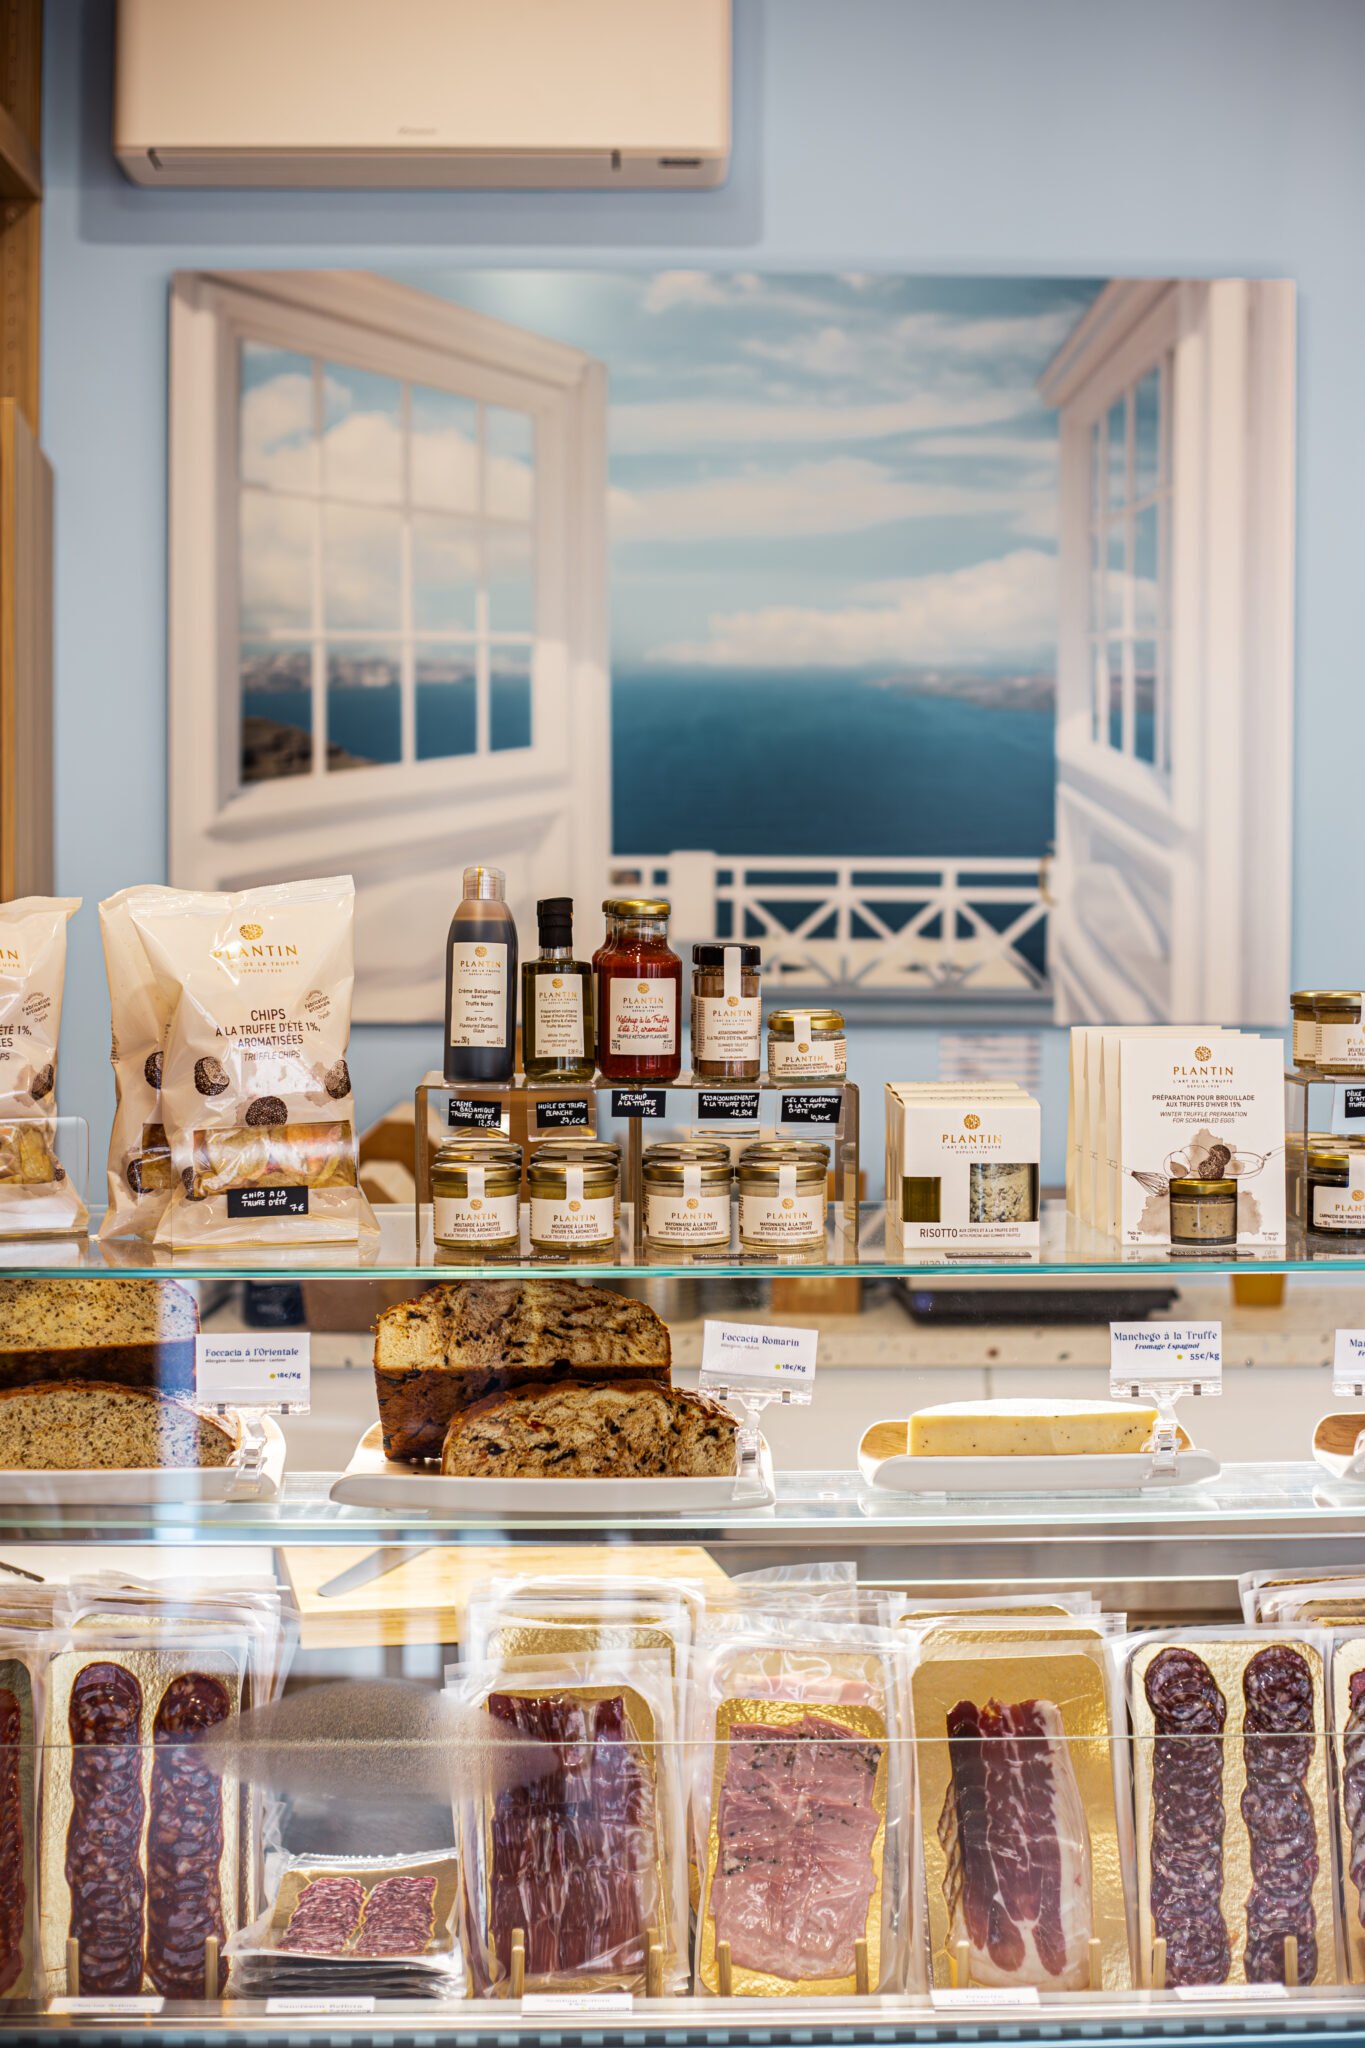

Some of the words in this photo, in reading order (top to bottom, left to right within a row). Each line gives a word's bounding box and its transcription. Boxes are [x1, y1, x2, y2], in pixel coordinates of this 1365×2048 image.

[213, 944, 298, 960] PLANTIN
[22, 997, 50, 1012] Fabrication
[250, 1008, 286, 1021] CHIPS
[616, 1014, 638, 1024] Ketchup
[645, 1016, 651, 1024] la
[225, 1026, 238, 1036] LA
[240, 1022, 276, 1034] TRUFFE
[279, 1020, 304, 1032] D'ÉTÉ
[238, 1033, 304, 1048] AROMATISÉES
[244, 1052, 278, 1062] TRUFFLE
[278, 1050, 301, 1059] CHIPS
[1173, 1066, 1233, 1075] PLANTIN
[620, 1092, 647, 1100] KETCHUP
[942, 1134, 1002, 1144] PLANTIN
[456, 1212, 498, 1220] PLANTIN
[920, 1228, 958, 1238] RISOTTO
[722, 1332, 759, 1343] Foccacia
[762, 1336, 800, 1347] Romarin
[1114, 1332, 1160, 1342] Manchego
[1174, 1332, 1182, 1340] la
[1186, 1331, 1218, 1340] Truffe
[205, 1349, 242, 1357] Foccacia
[254, 1348, 299, 1356] l'Orientale
